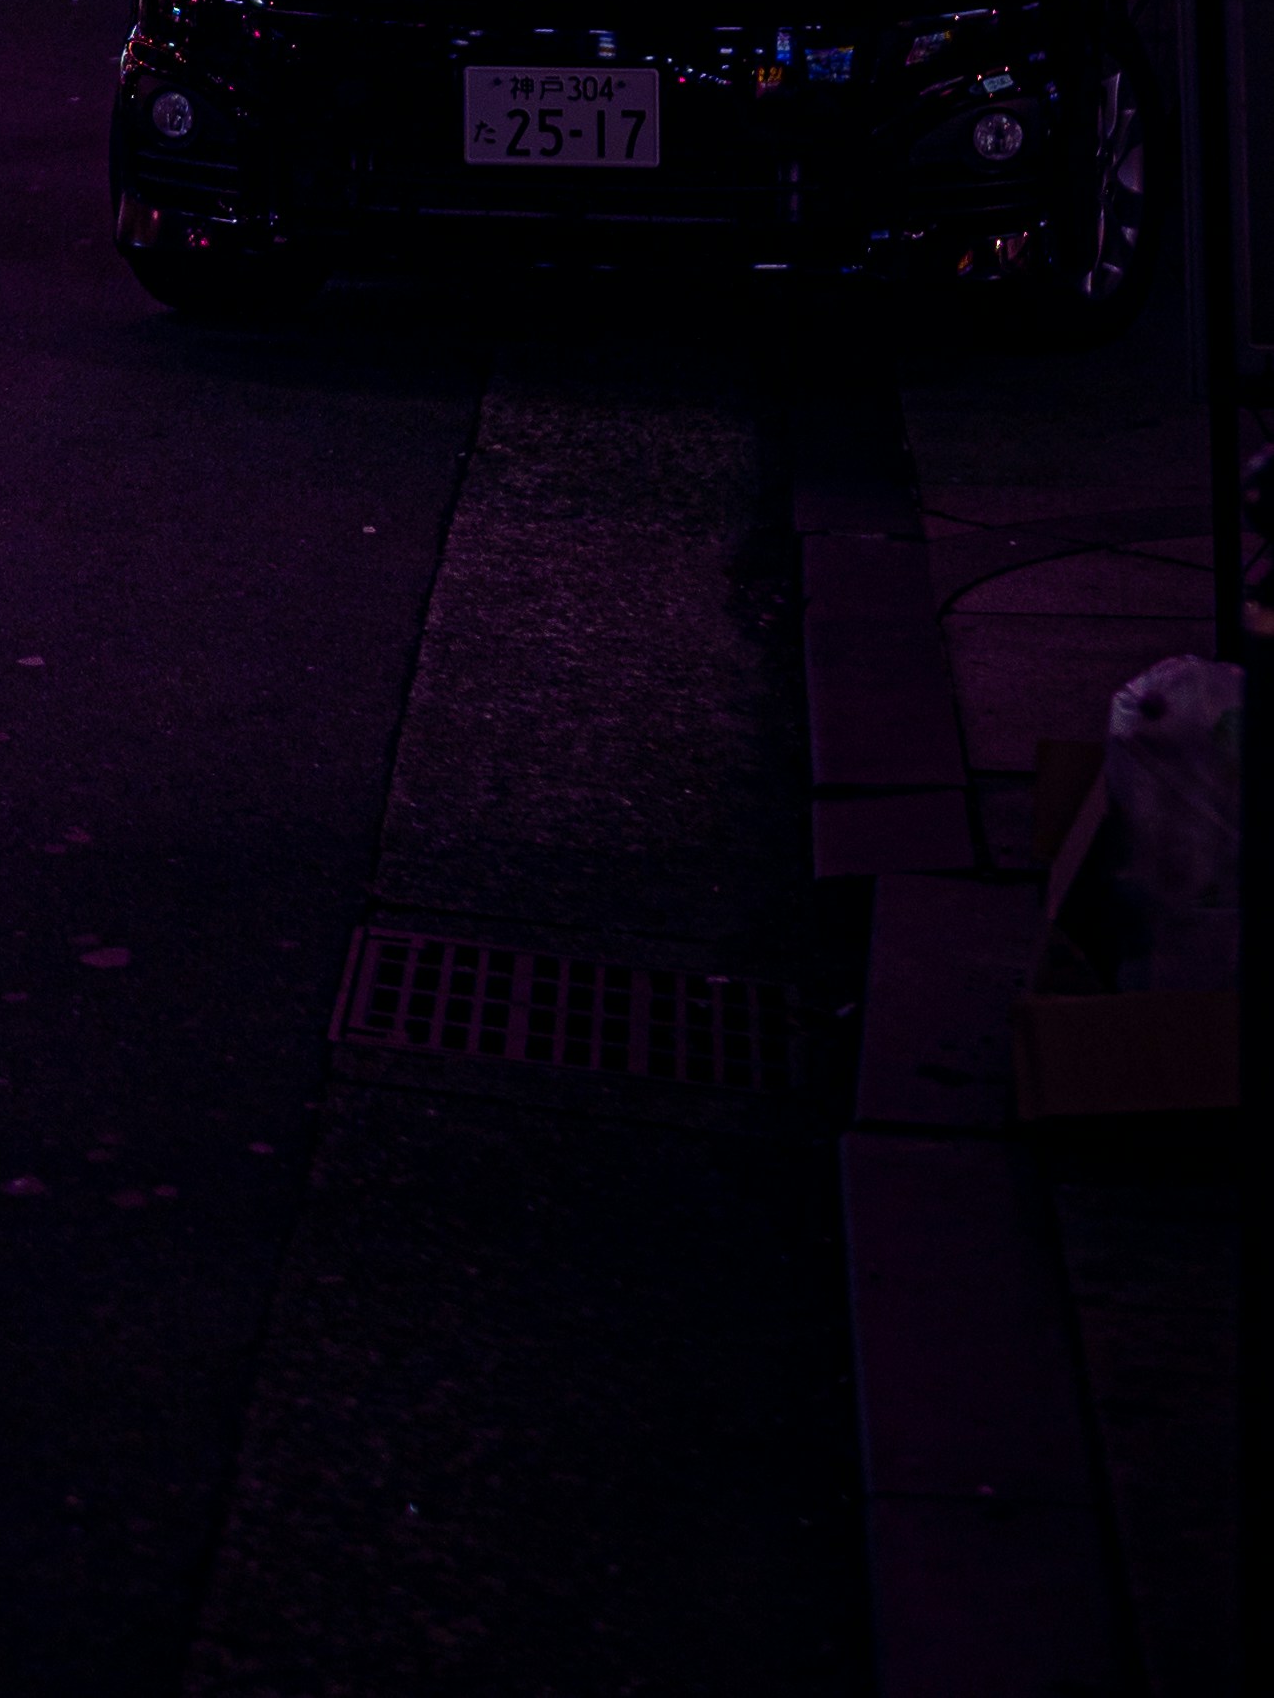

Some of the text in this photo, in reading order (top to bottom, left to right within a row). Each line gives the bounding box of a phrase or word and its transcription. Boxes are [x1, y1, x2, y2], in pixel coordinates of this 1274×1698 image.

[510, 76, 614, 101] 神戸304
[474, 108, 647, 159] た 25-17
